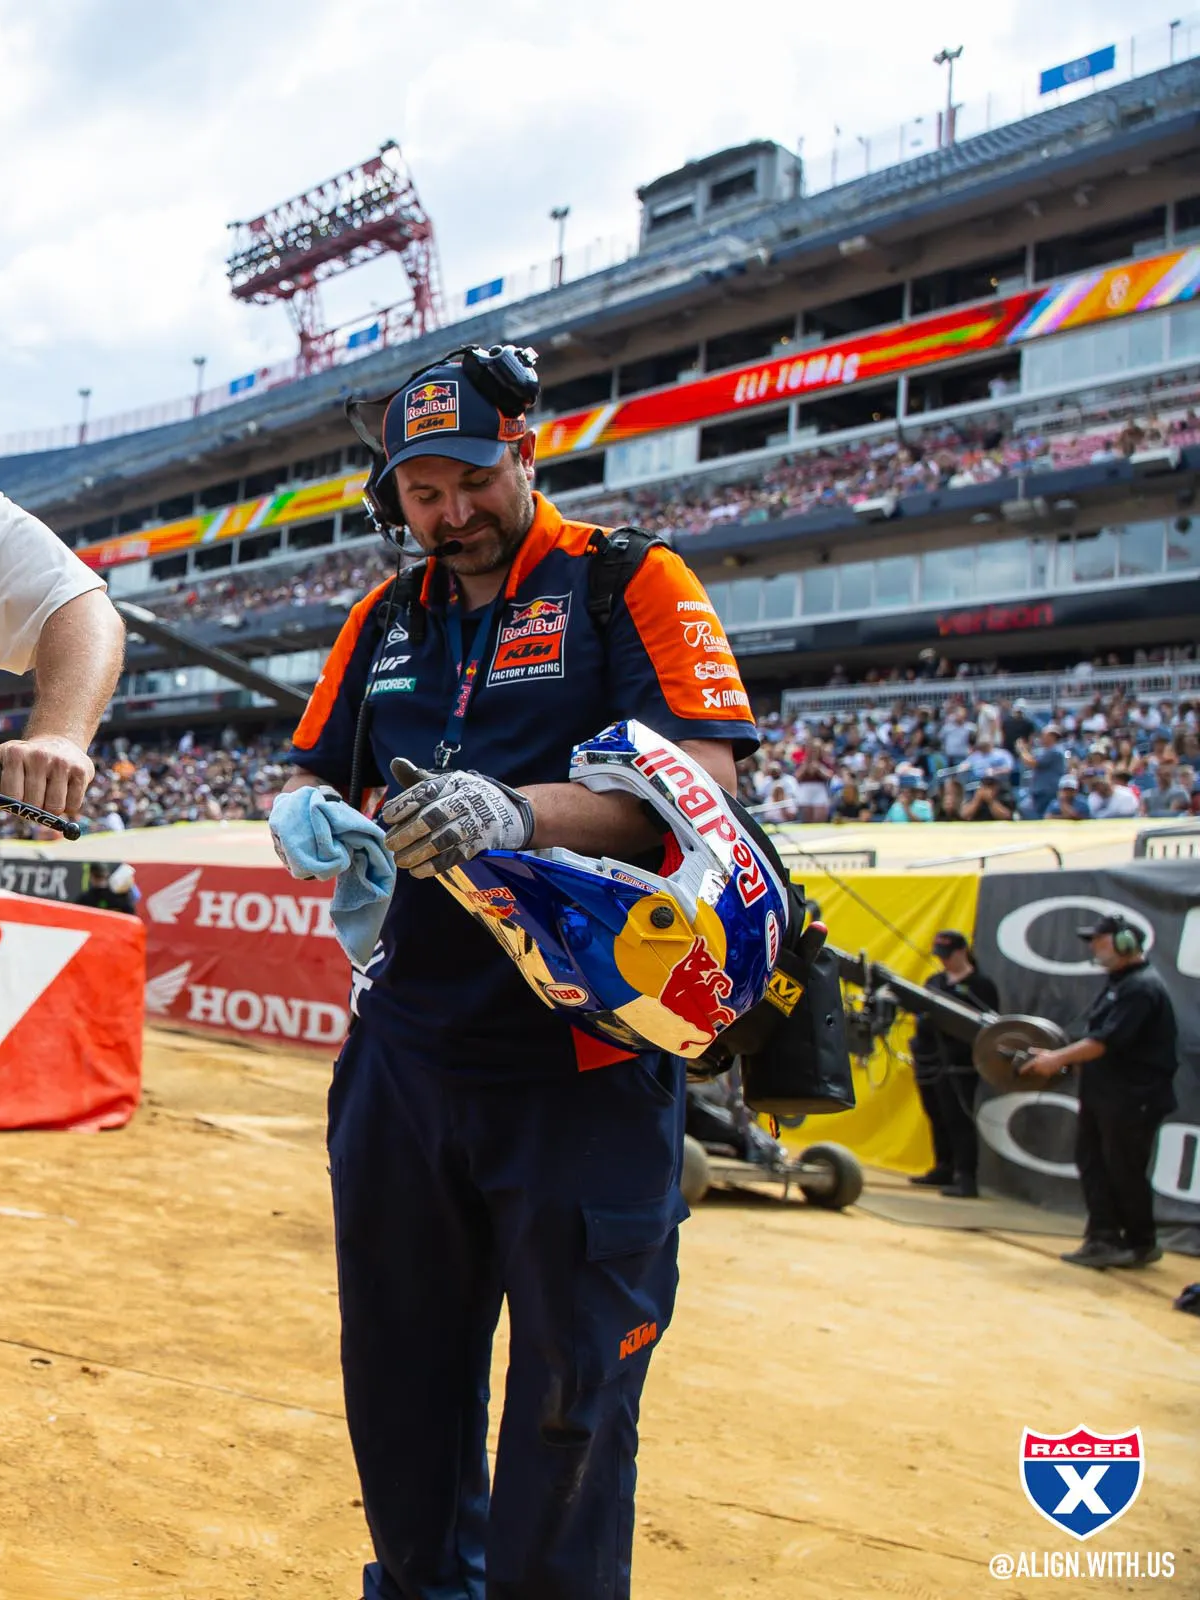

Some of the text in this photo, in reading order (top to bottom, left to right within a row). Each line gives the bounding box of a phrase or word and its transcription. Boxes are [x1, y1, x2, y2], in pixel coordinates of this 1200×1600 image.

[407, 397, 456, 421] Red Bull
[501, 614, 566, 643] Red Bull
[936, 604, 1054, 636] verizon
[503, 642, 553, 661] KTM
[490, 662, 560, 681] FACTORY RACING
[633, 747, 718, 820] Bull
[696, 813, 768, 907] Red
[547, 989, 583, 1000] BELL
[188, 984, 349, 1043] HOND
[619, 1321, 657, 1360] KTM
